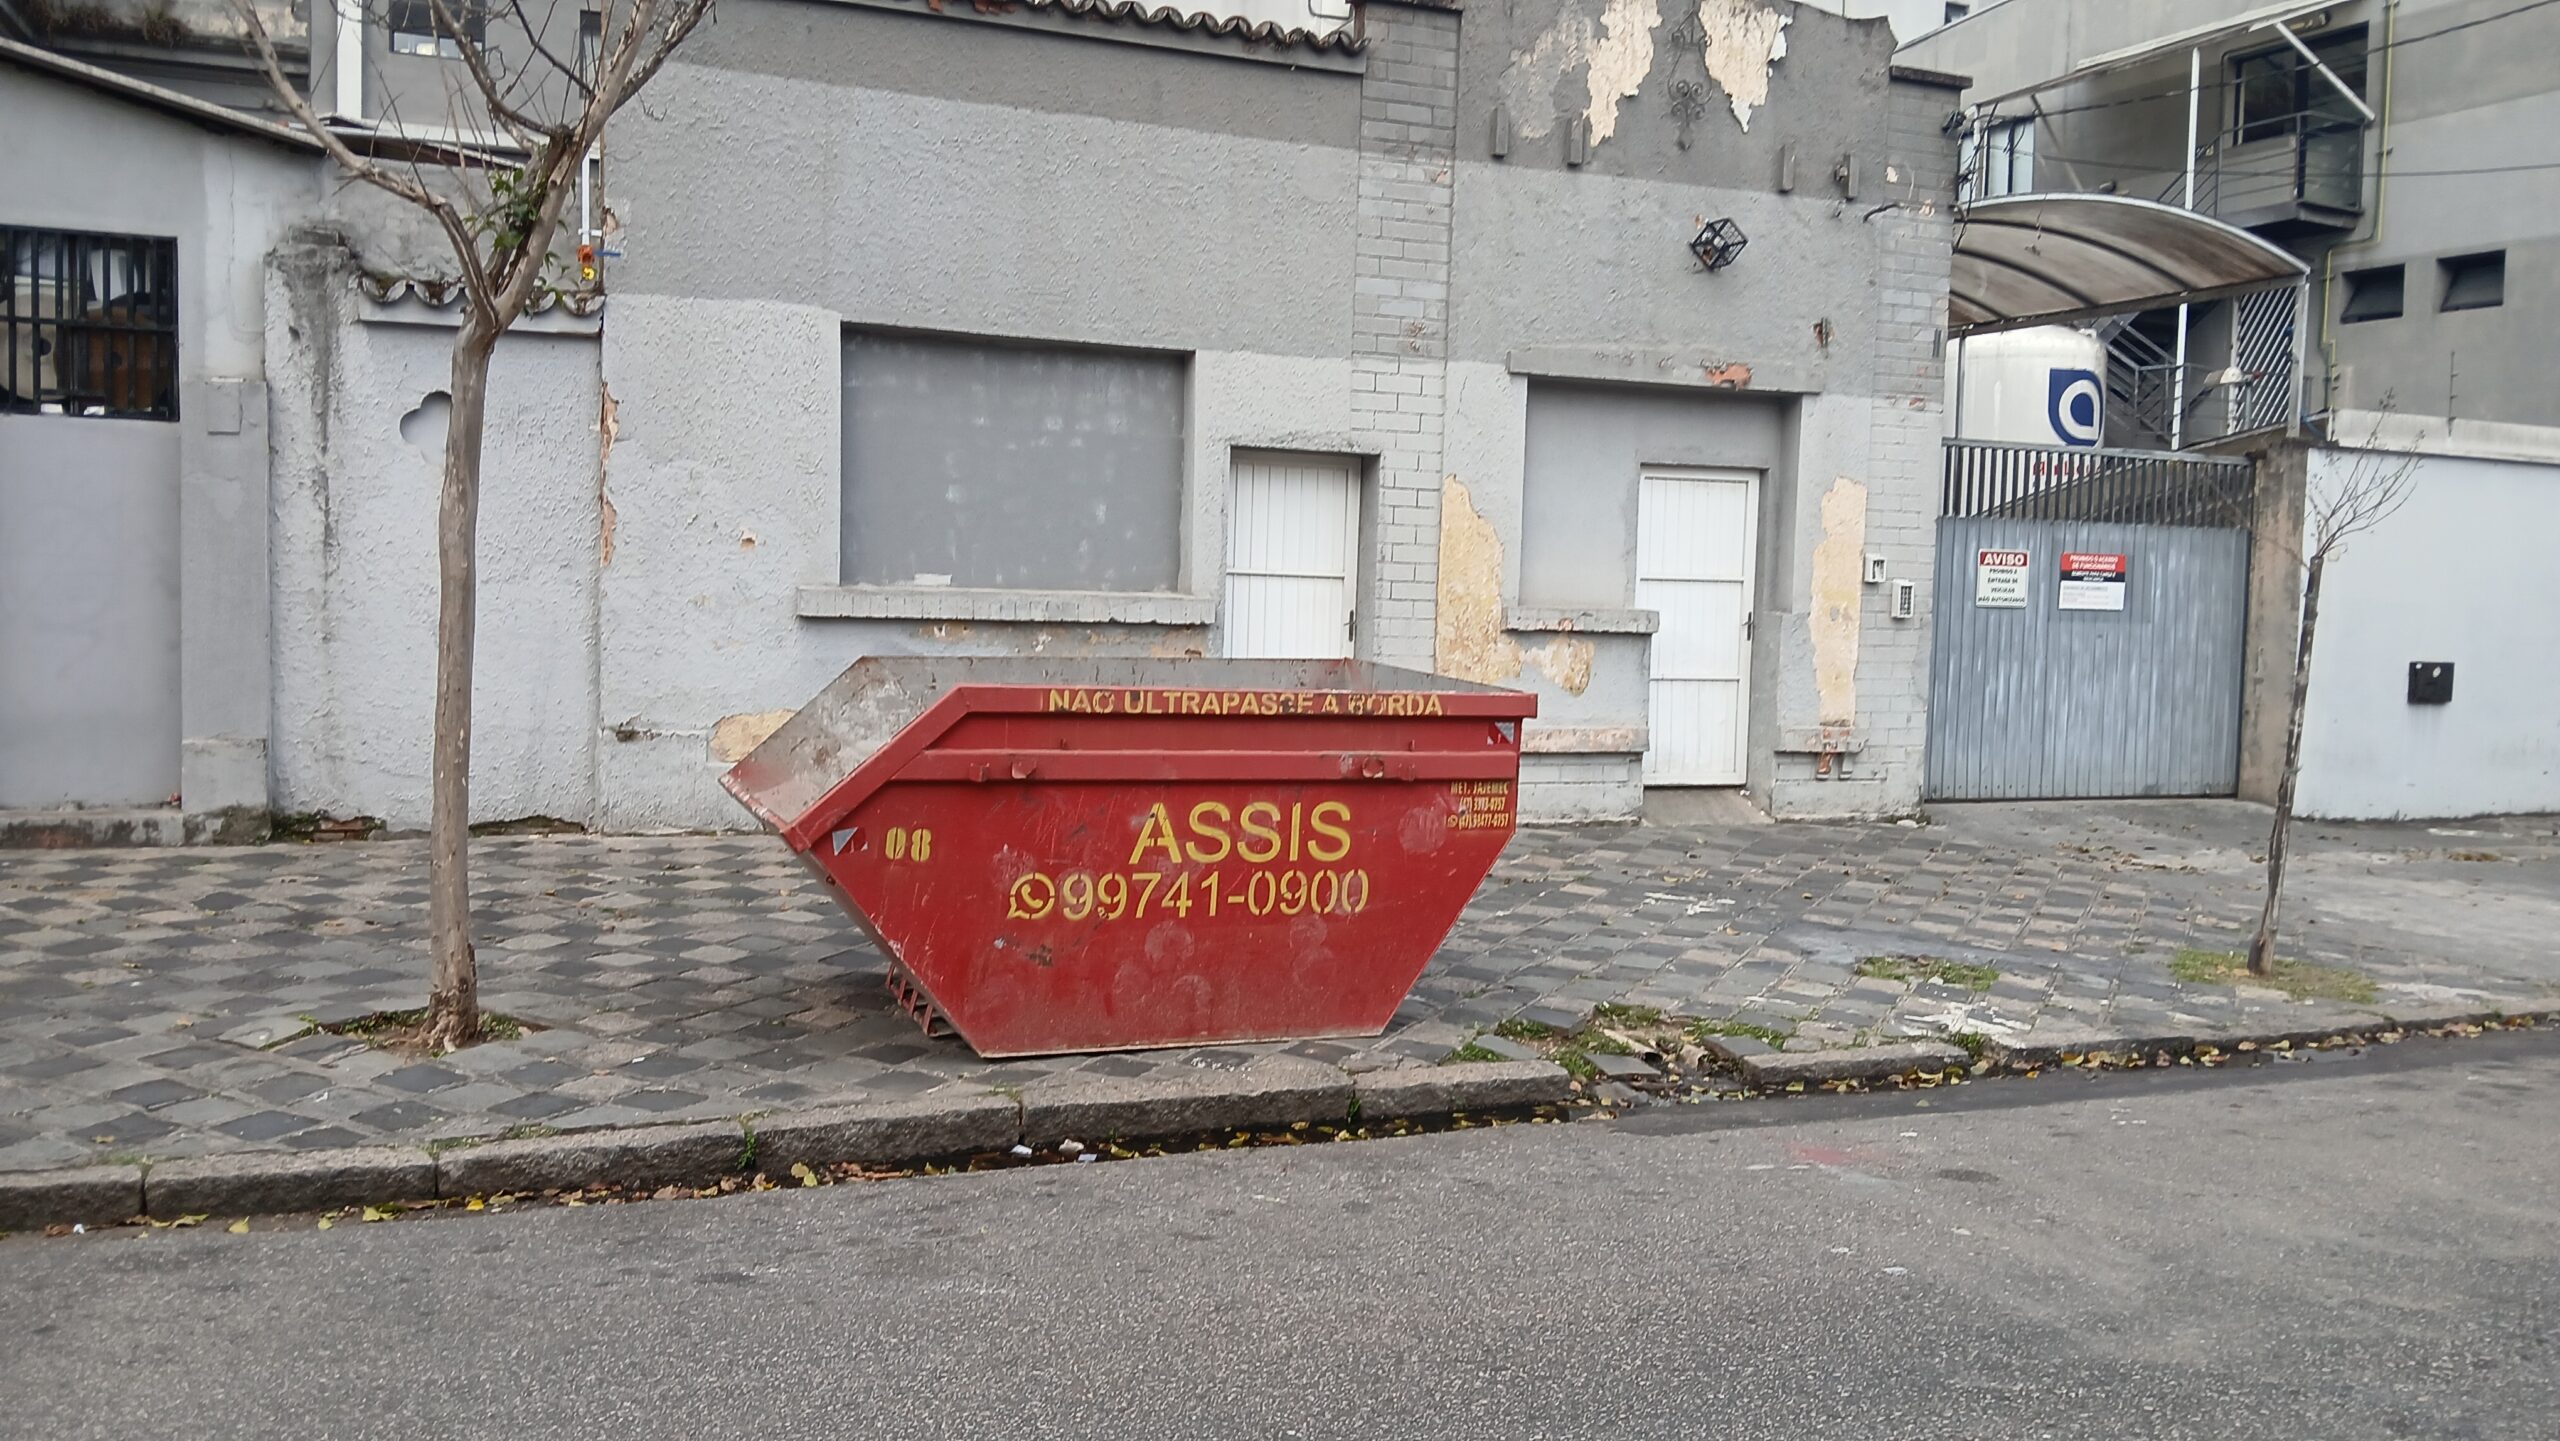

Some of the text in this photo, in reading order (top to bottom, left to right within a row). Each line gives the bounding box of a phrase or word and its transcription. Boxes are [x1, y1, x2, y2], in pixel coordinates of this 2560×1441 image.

[1983, 552, 2025, 566] AVISO
[1321, 694, 1339, 714] A
[885, 826, 931, 862] 08
[1129, 801, 1351, 864] ASSIS
[1063, 869, 1370, 920] 99741-0900
